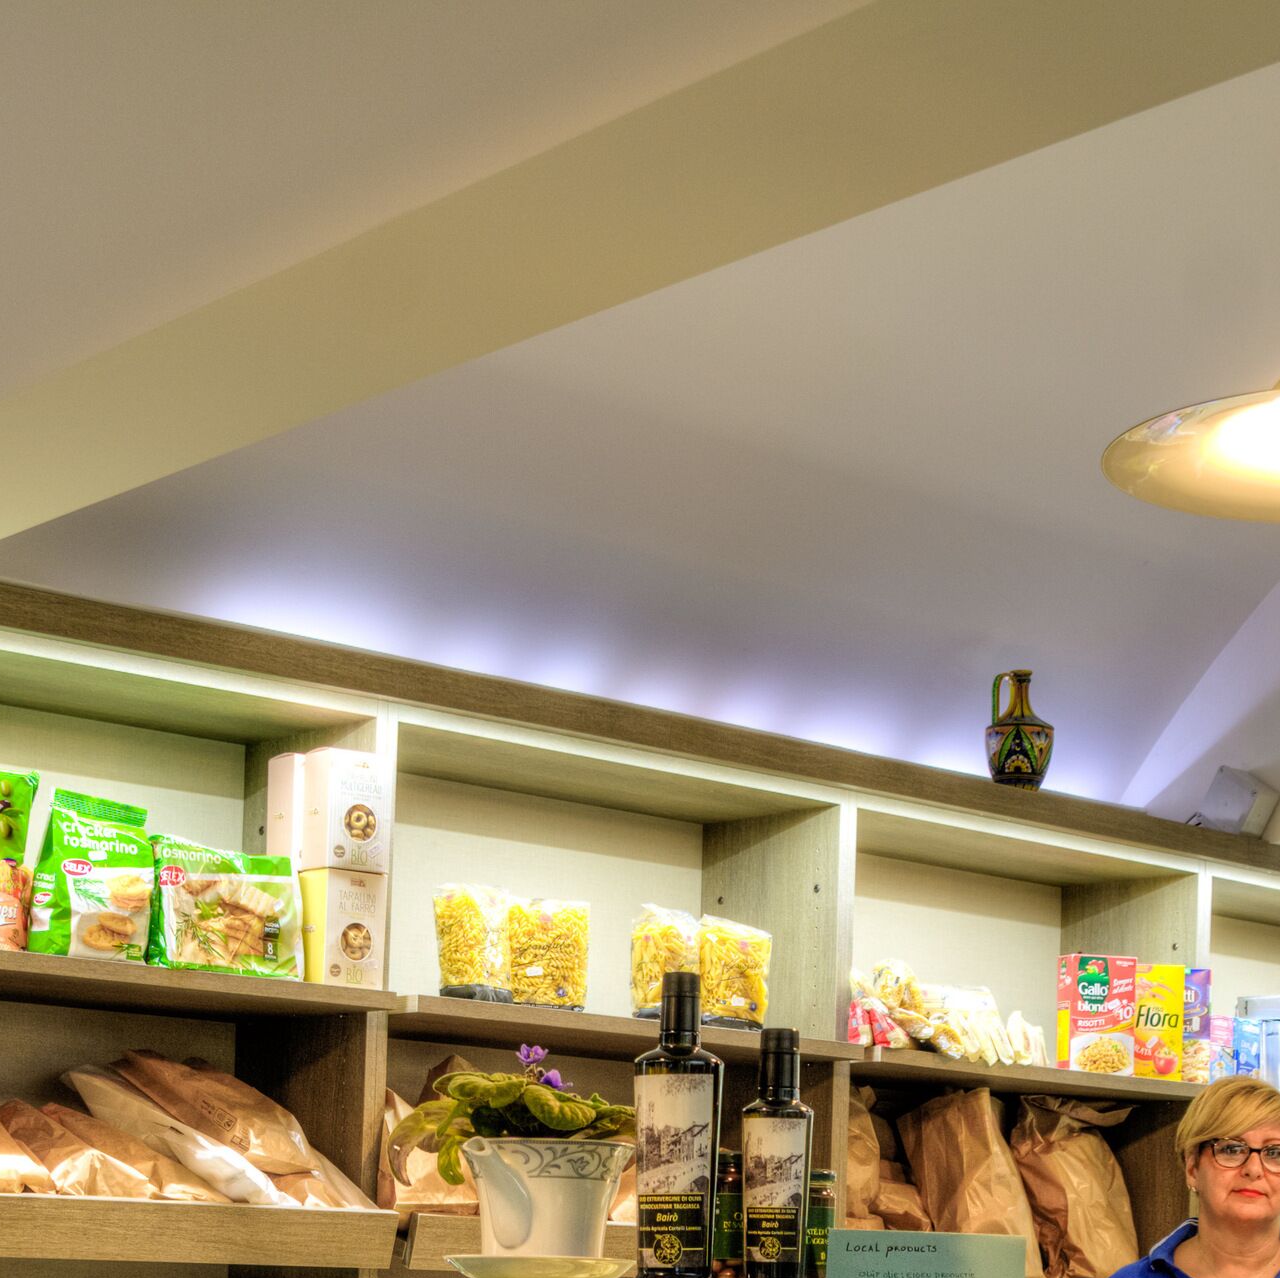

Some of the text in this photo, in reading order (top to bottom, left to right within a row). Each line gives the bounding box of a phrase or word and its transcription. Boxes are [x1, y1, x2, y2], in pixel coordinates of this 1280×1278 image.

[63, 835, 138, 855] rosmarino
[64, 862, 91, 875] SELEX
[266, 942, 274, 954] 8
[1077, 983, 1109, 996] Gallo
[1077, 1000, 1108, 1013] blond
[1136, 1005, 1180, 1029] Flora
[656, 1212, 679, 1222] Bairò
